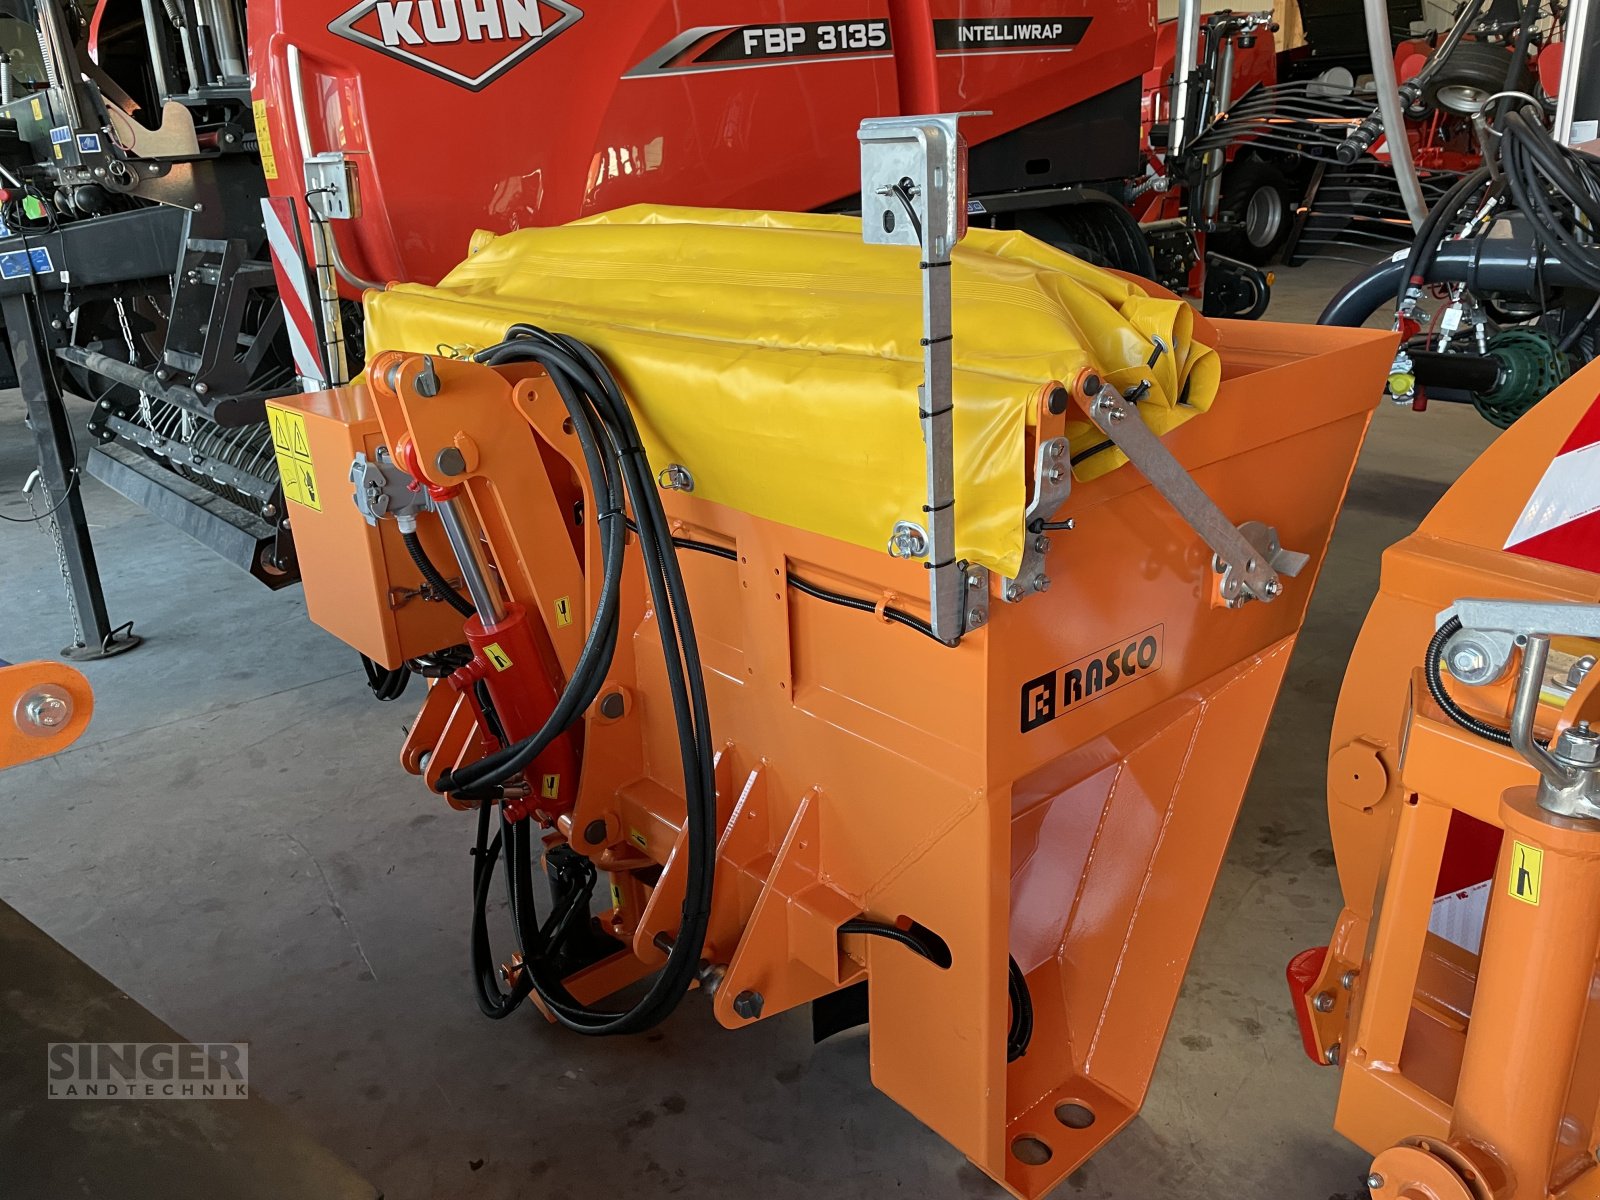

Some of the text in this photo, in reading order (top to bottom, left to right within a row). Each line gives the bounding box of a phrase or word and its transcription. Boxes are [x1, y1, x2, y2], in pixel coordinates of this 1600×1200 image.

[376, 0, 543, 46] KUHN
[743, 23, 886, 55] FBP 3135
[958, 24, 1062, 42] INTELLIWRAP
[1064, 635, 1157, 707] RASCO
